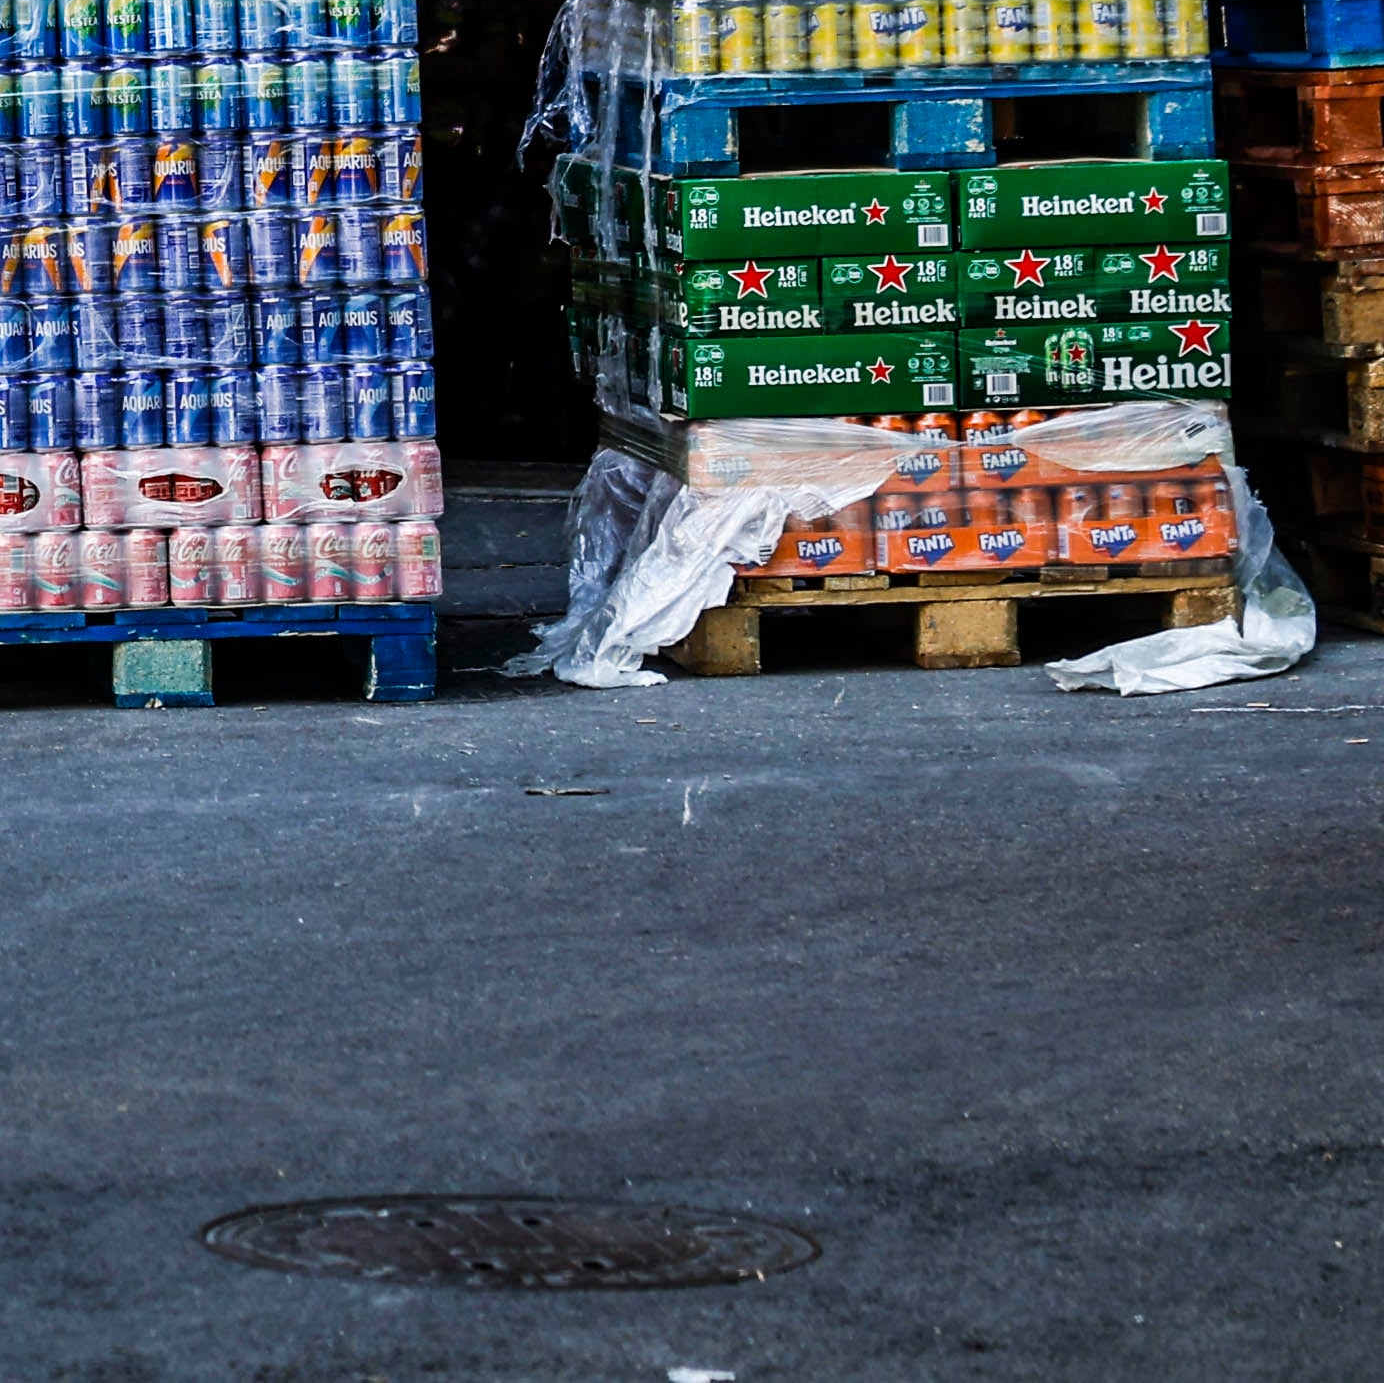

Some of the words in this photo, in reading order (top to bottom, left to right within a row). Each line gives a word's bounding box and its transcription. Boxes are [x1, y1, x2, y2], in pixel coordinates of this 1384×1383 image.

[64, 16, 98, 28] NESTEA
[106, 14, 142, 26] NESTEA
[106, 91, 142, 105] NESTEA
[968, 197, 987, 212] 18
[1021, 193, 1134, 217] Heineken
[689, 208, 708, 223] 18
[743, 205, 855, 228] Heineken
[1053, 255, 1073, 270] 18
[1187, 249, 1207, 265] 18
[777, 266, 796, 280] 18
[916, 260, 935, 276] 18
[994, 293, 1097, 320] Heinek
[1129, 289, 1232, 314] Heinek
[718, 303, 822, 331] Heinek
[852, 298, 956, 328] Heinek
[694, 367, 713, 381] 18
[748, 363, 861, 387] Heineken
[896, 453, 942, 474] FANTA
[982, 448, 1028, 470] FANTA
[1090, 524, 1137, 545] FANTA
[1160, 518, 1206, 539] FANTA
[797, 537, 844, 558] FANTA
[908, 533, 954, 554] FANTA
[979, 530, 1025, 551] FANTA
